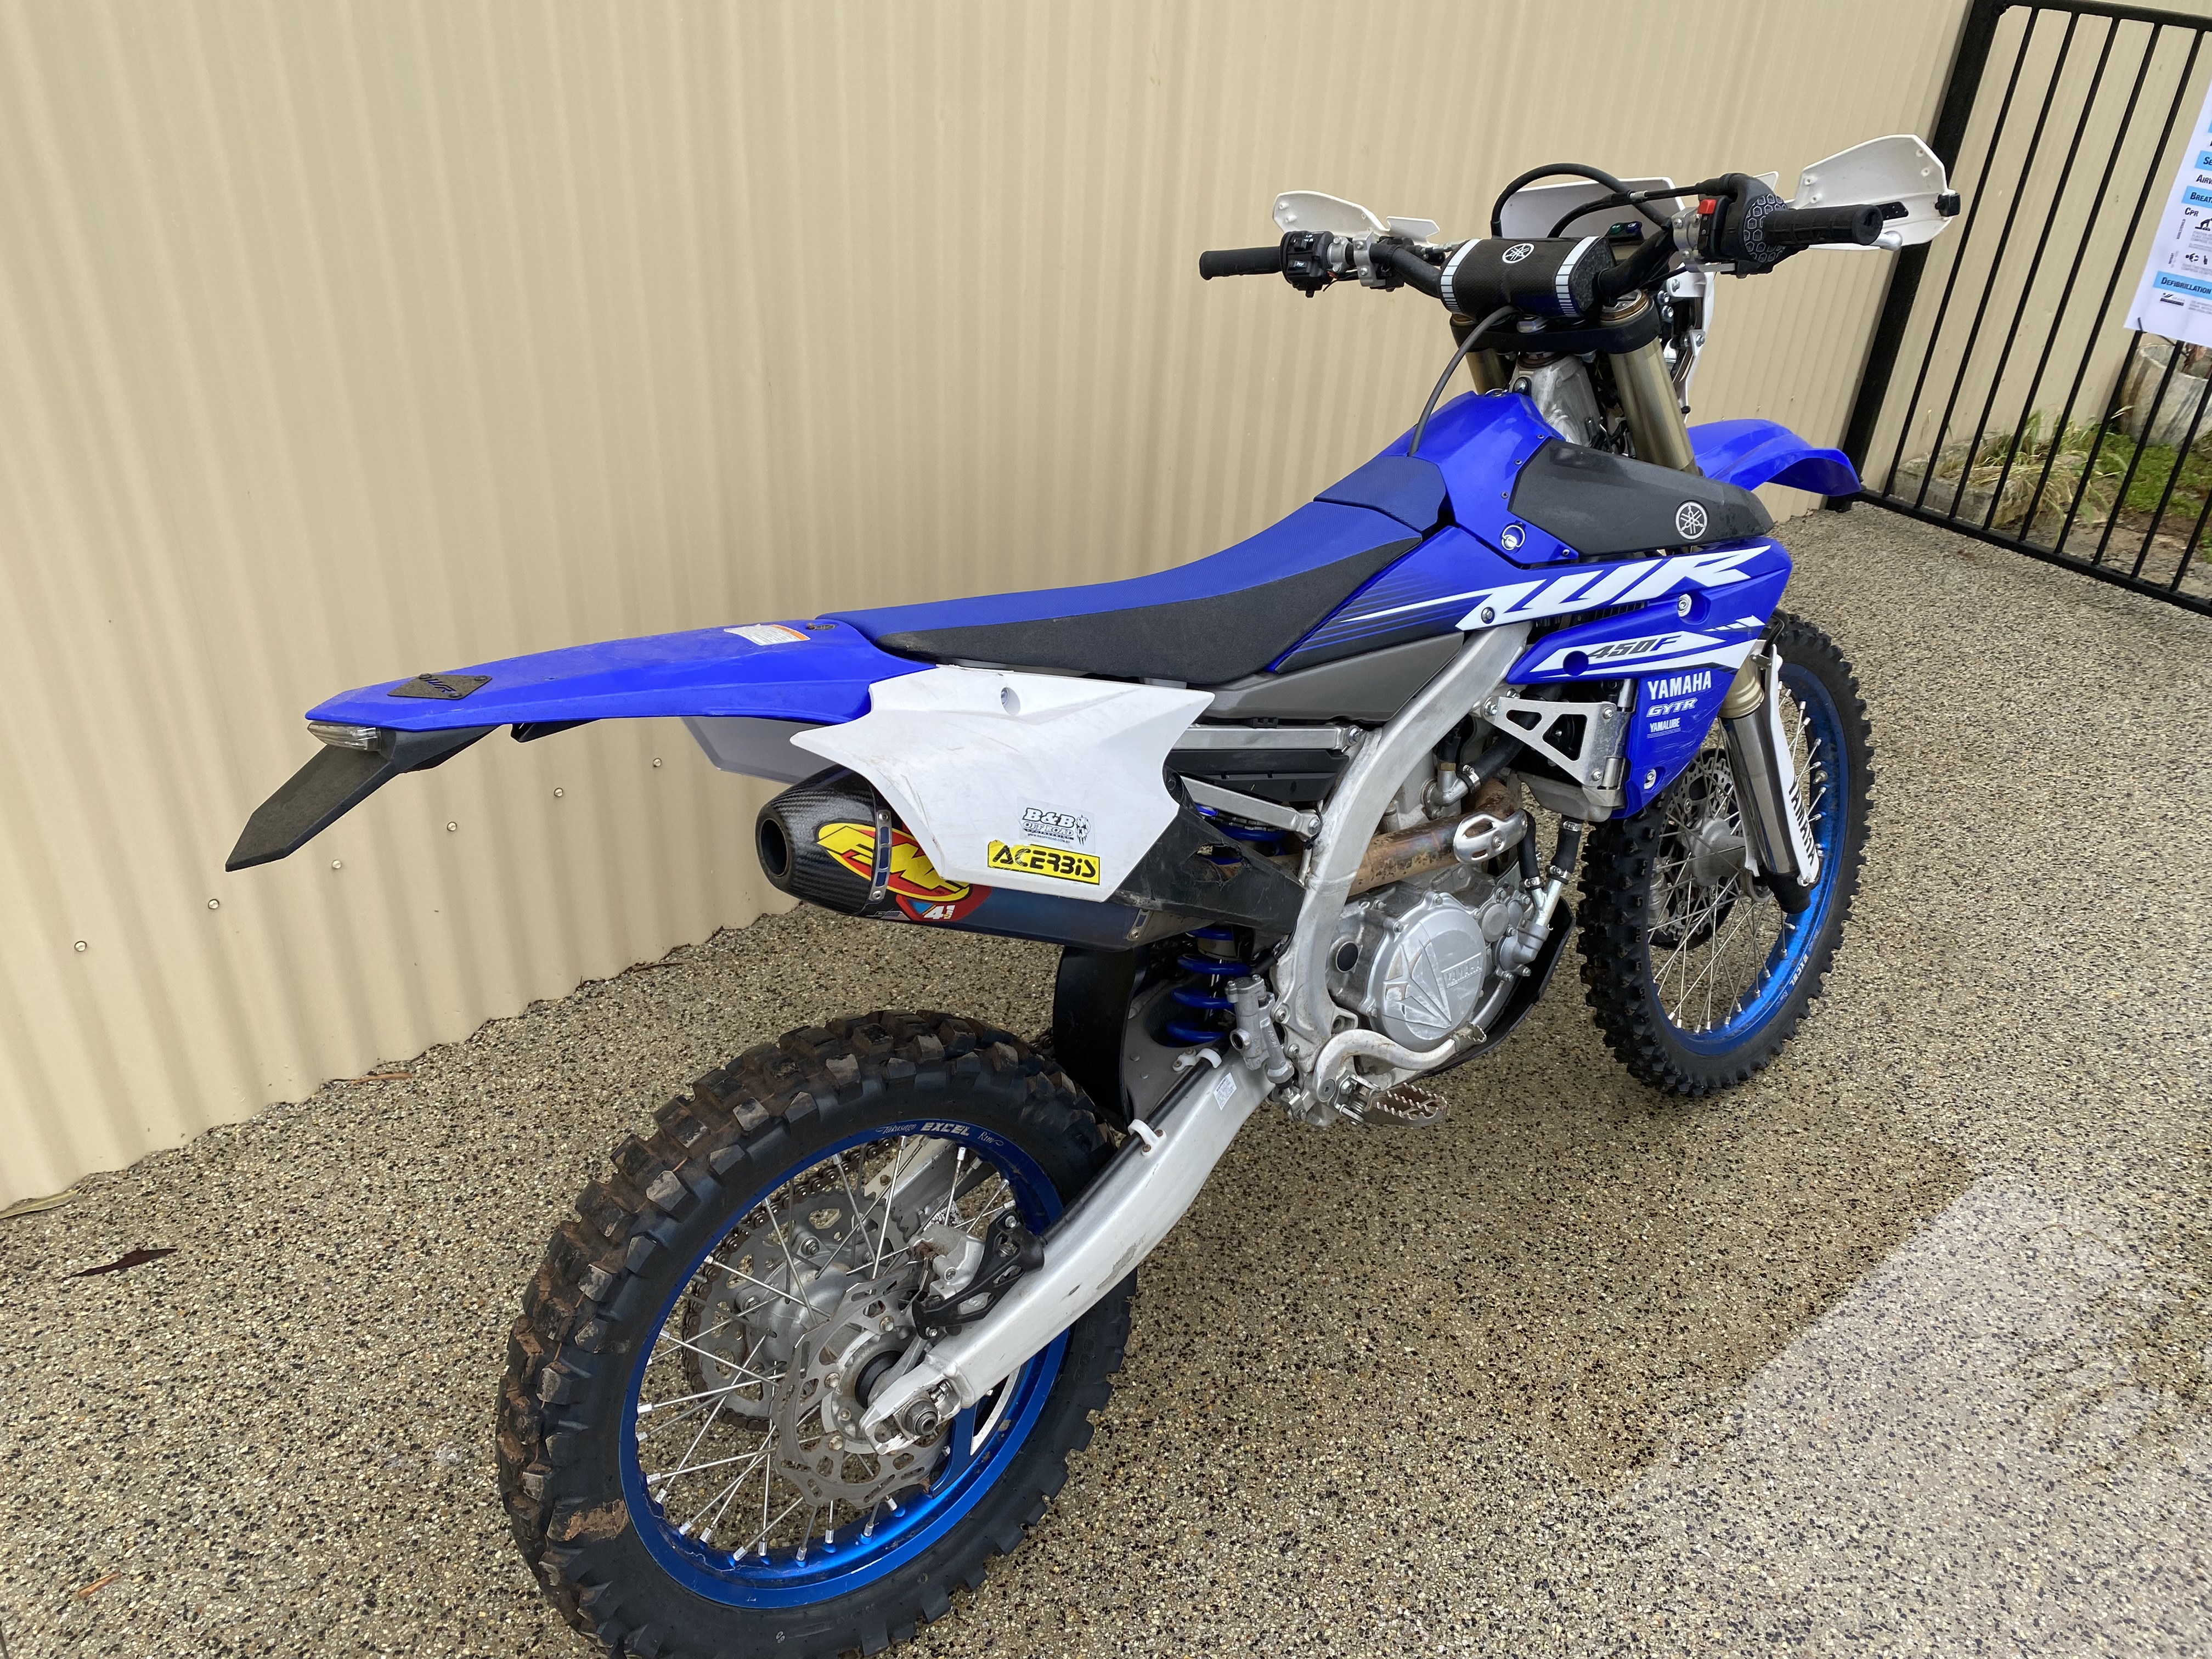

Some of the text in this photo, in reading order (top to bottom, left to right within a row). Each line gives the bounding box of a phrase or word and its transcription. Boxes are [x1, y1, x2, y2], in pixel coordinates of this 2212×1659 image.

[2190, 192, 2212, 204] BREAT
[2160, 276, 2212, 295] DEFIBRILLATION
[1587, 635, 1682, 659] 450F
[1647, 670, 1711, 700] YAMAHA
[1646, 697, 1698, 718] GYTR
[1650, 718, 1680, 733] YAMALUBE
[1022, 808, 1076, 828] B&B
[1788, 774, 1815, 867] YAMAHA
[1023, 821, 1045, 831] OFF
[1045, 825, 1074, 837] ROAD
[1789, 953, 1809, 986] EXCEL
[920, 1122, 970, 1136] EXCEL
